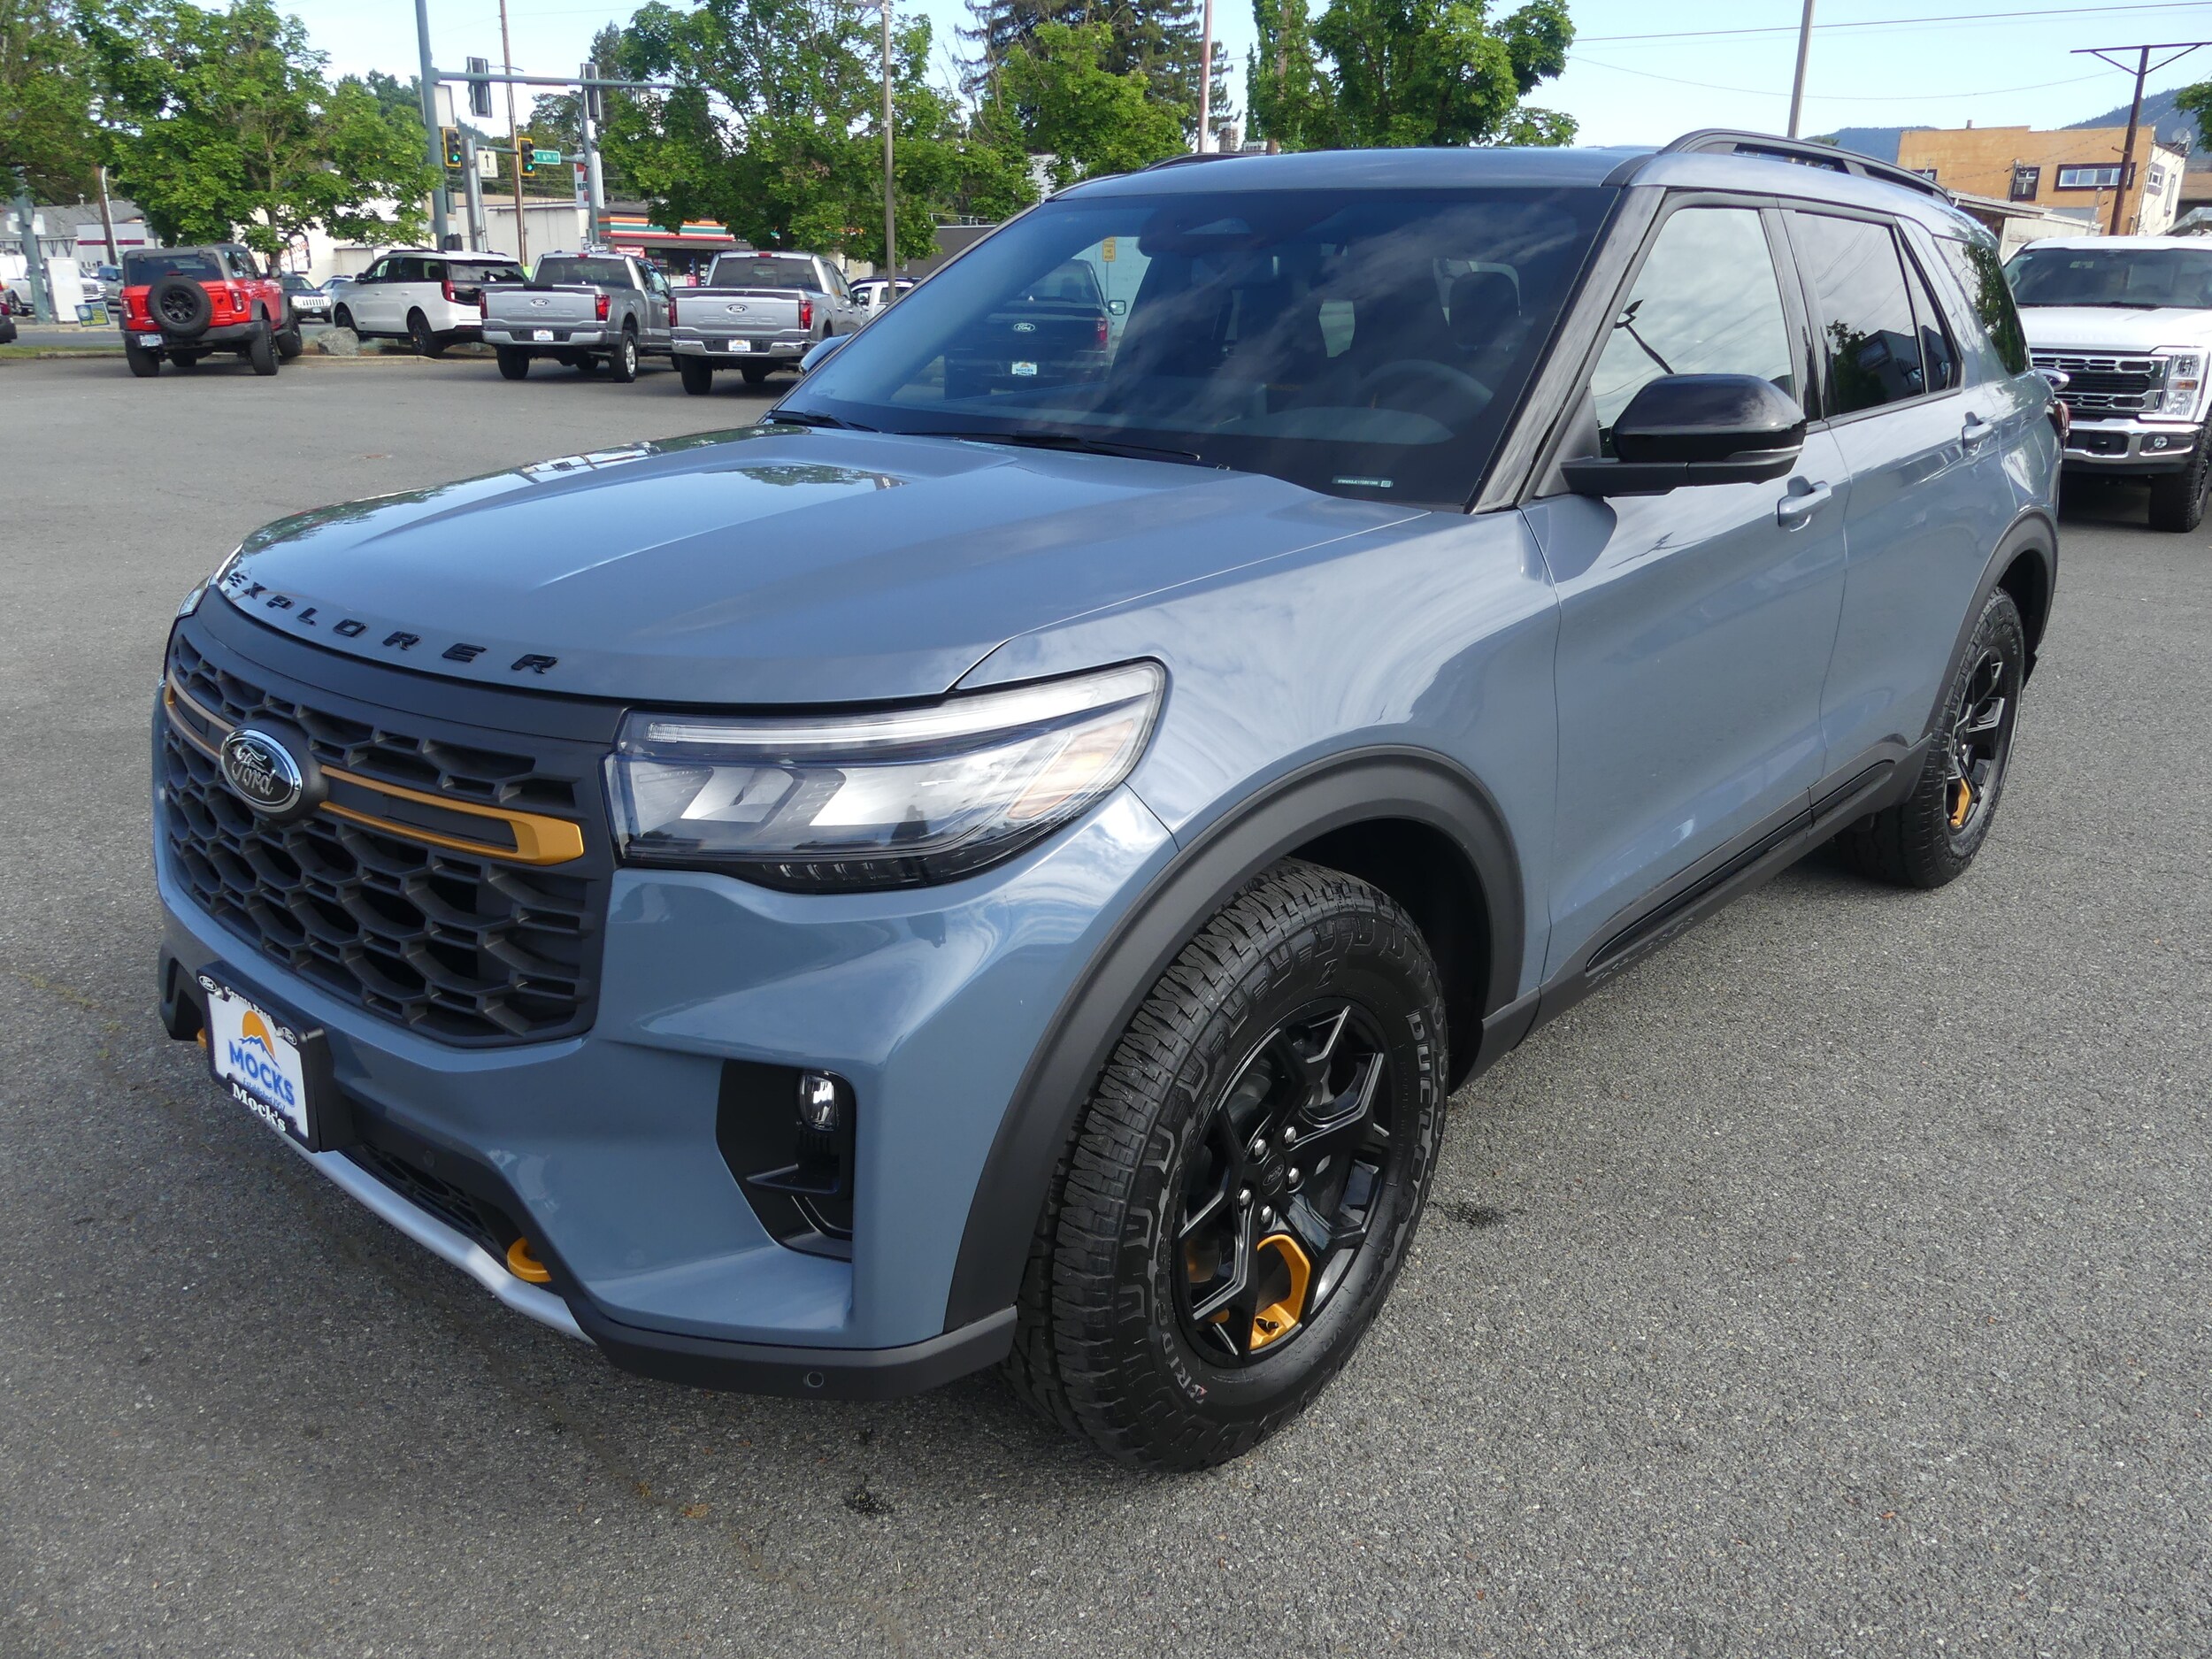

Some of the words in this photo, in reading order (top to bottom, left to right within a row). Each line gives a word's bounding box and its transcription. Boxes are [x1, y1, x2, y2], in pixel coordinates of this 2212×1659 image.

[226, 571, 559, 674] EXPLORER
[231, 744, 276, 796] Ford
[227, 1040, 296, 1107] MOCKS
[232, 1082, 287, 1132] Mock's
